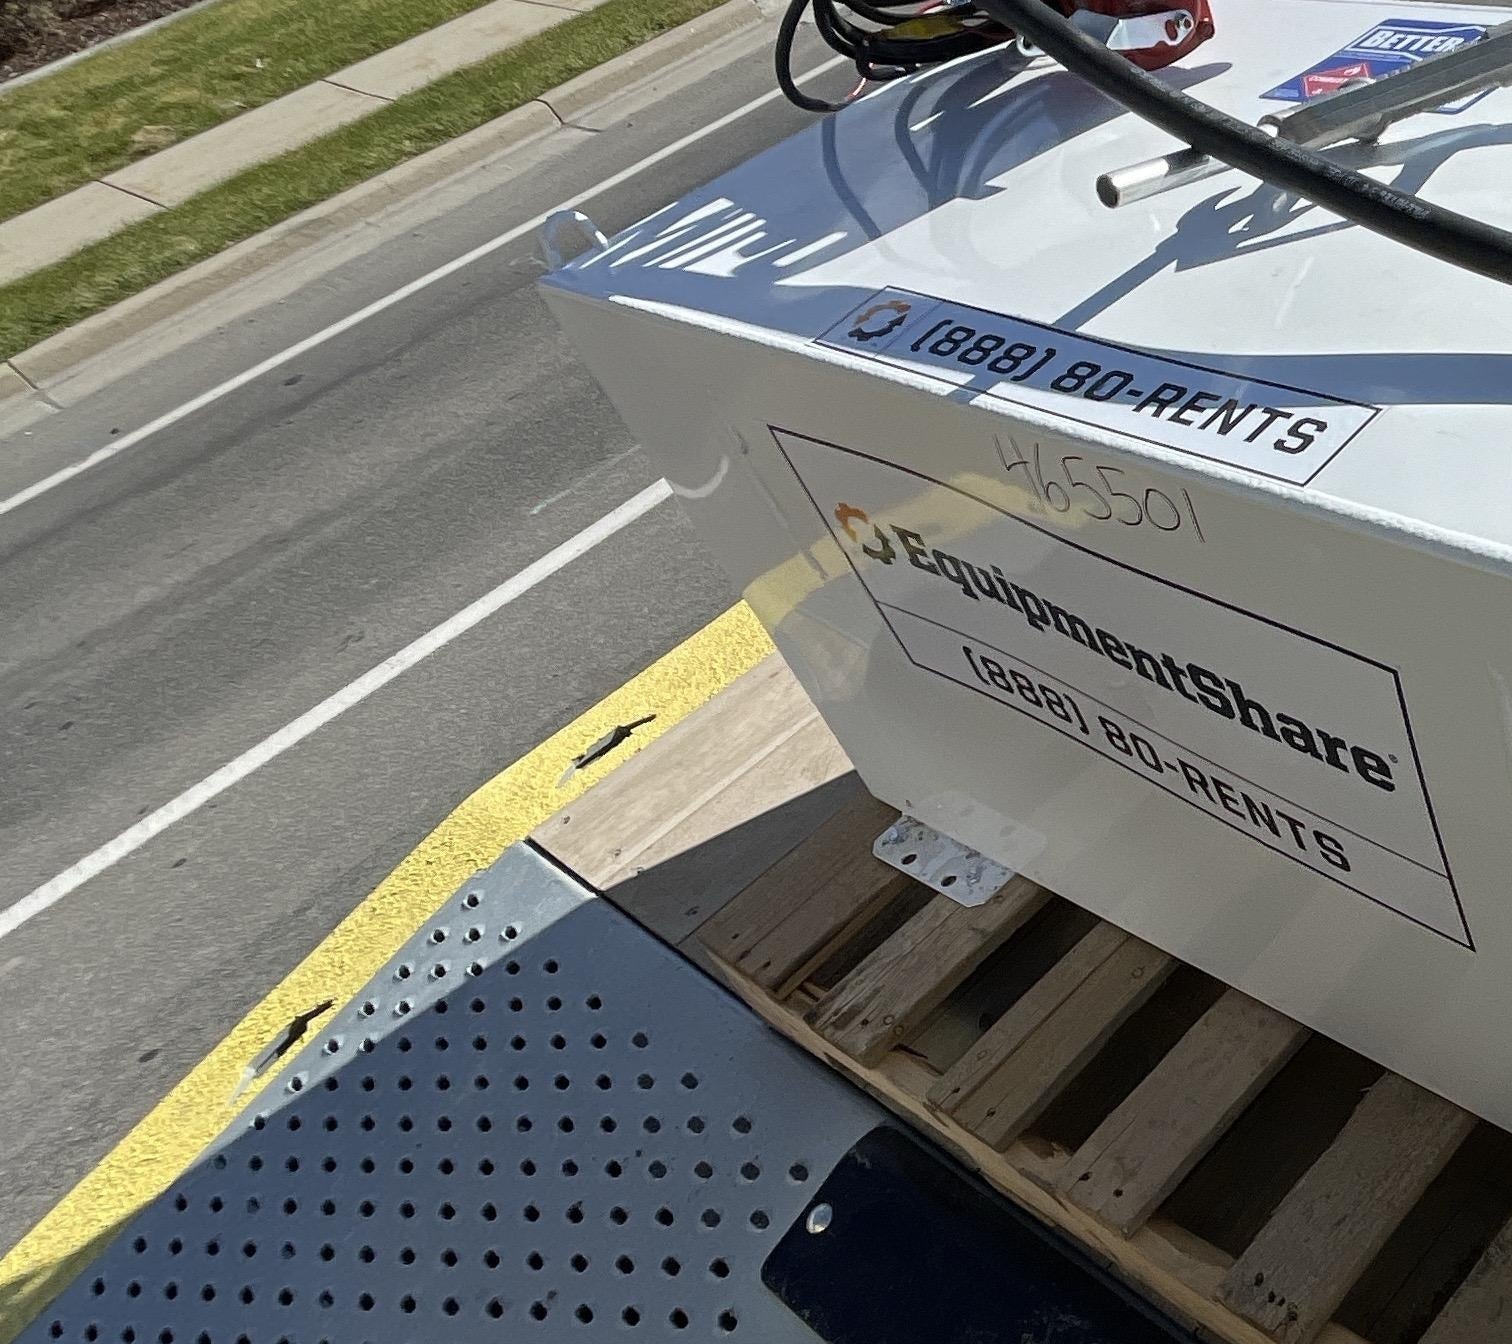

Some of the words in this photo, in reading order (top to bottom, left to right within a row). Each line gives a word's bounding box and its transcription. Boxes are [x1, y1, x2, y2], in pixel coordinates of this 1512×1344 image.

[1361, 30, 1464, 53] BETTER
[910, 318, 1057, 382] (888)
[1050, 359, 1328, 455] 80-RENTS
[992, 432, 1206, 544] 465501
[889, 524, 1396, 793] EquipmentShare
[962, 644, 1092, 736] (888)
[1097, 714, 1352, 873] 80-RENTS
